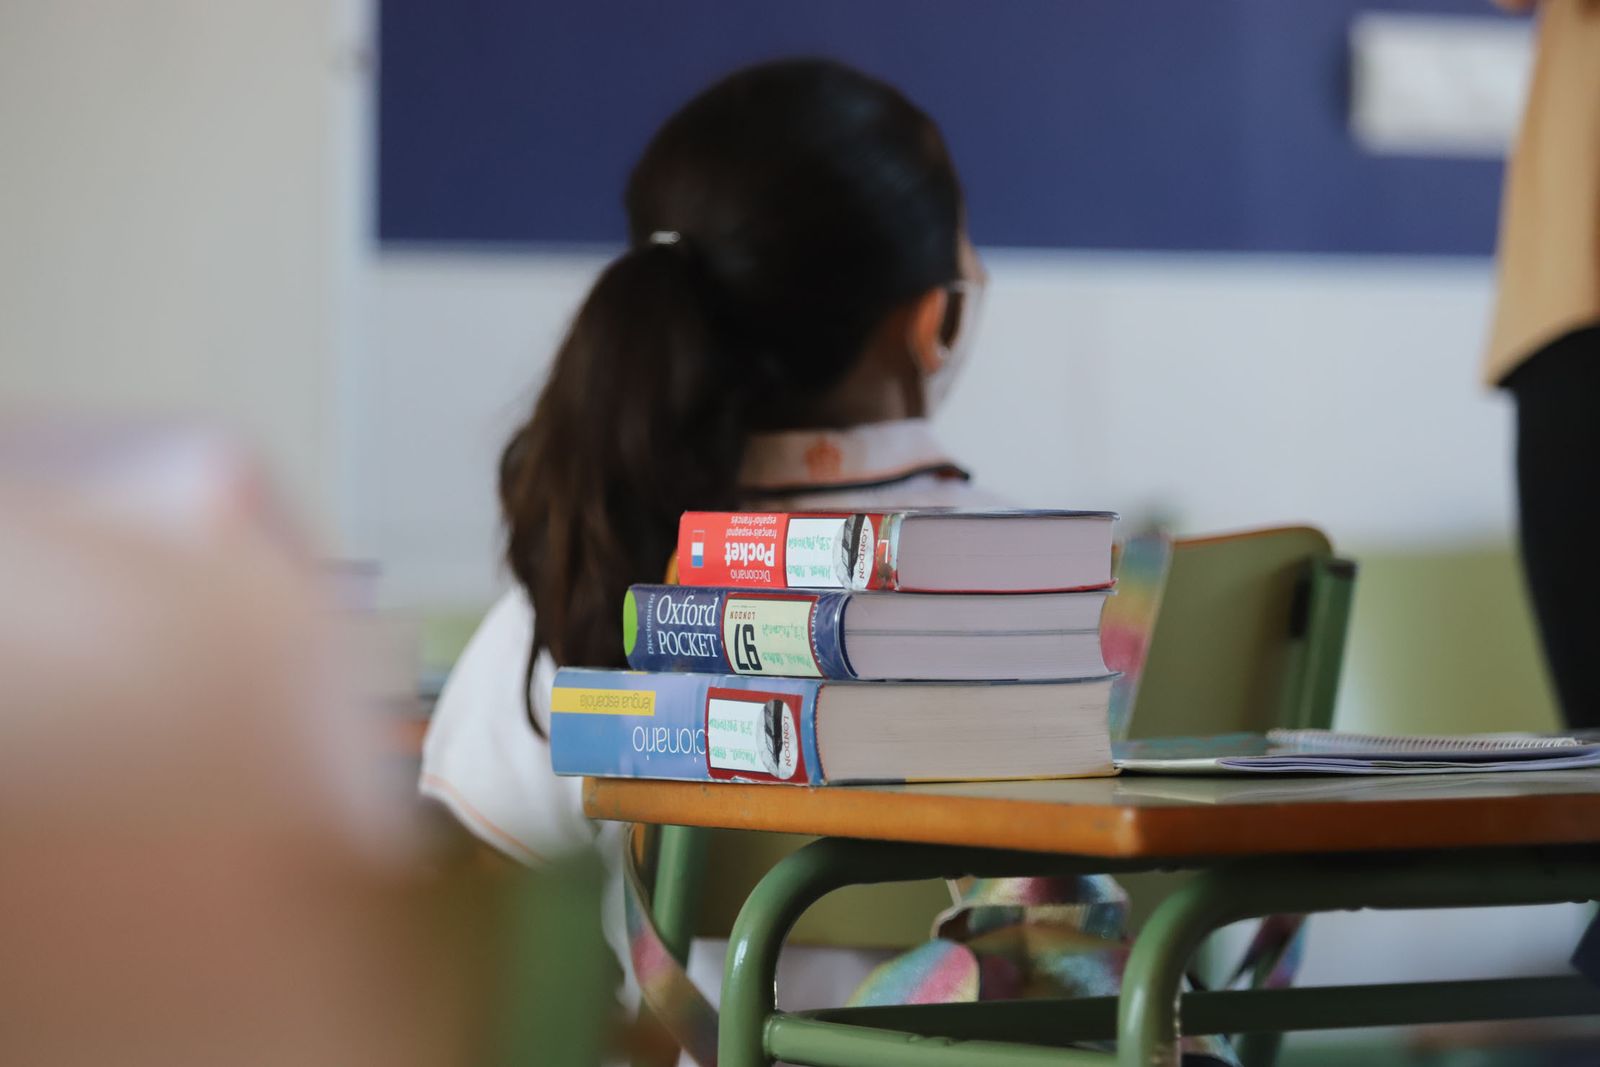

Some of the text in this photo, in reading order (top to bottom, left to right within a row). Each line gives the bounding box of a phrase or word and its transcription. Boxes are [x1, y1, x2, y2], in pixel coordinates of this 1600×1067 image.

[725, 542, 775, 566] Pocket
[857, 527, 869, 580] LONDON
[730, 569, 771, 582] Diccionario
[647, 593, 656, 655] Diccionario
[657, 595, 718, 626] Oxford
[729, 610, 756, 620] LONDON
[658, 631, 718, 657] POCKET
[735, 624, 763, 671] 97
[622, 692, 652, 713] lengua
[782, 715, 793, 768] LONDON
